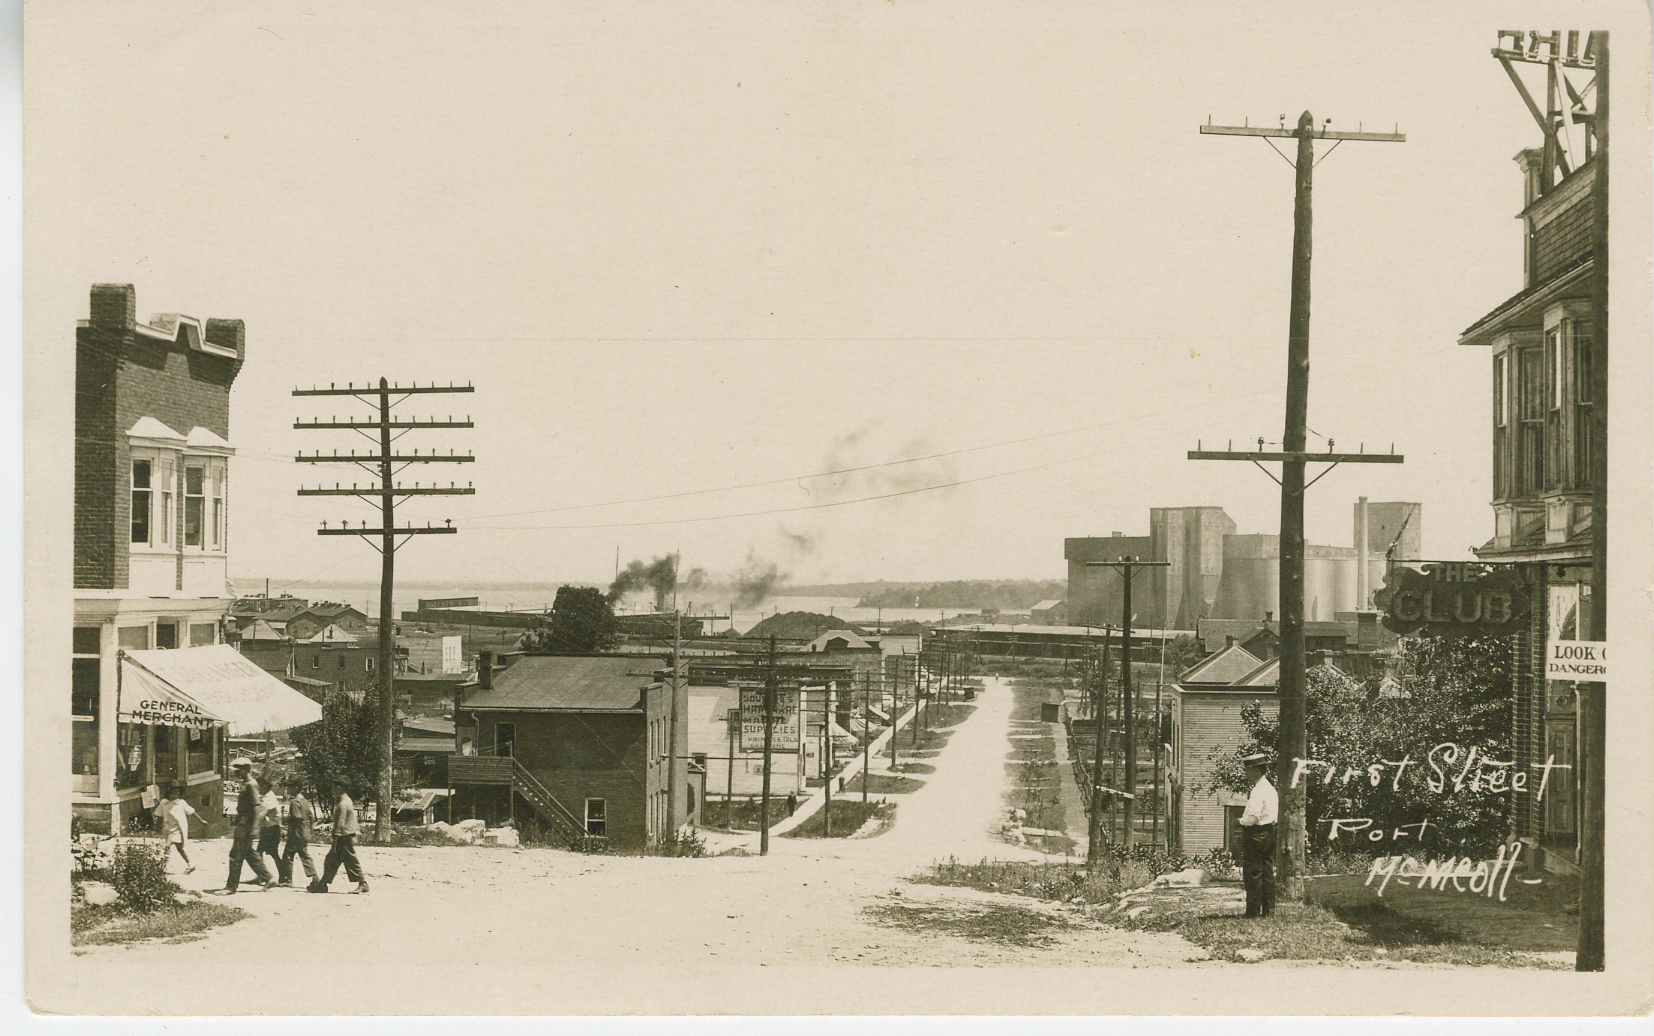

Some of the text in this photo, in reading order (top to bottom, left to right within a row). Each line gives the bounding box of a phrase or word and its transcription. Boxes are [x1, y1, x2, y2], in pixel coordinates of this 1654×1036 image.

[1433, 563, 1478, 583] THE
[1393, 587, 1513, 624] CLUB
[1554, 645, 1597, 660] LOOK
[140, 700, 202, 715] GENERAL
[132, 710, 212, 727] MERCHANT
[744, 725, 795, 734] SUPLIES
